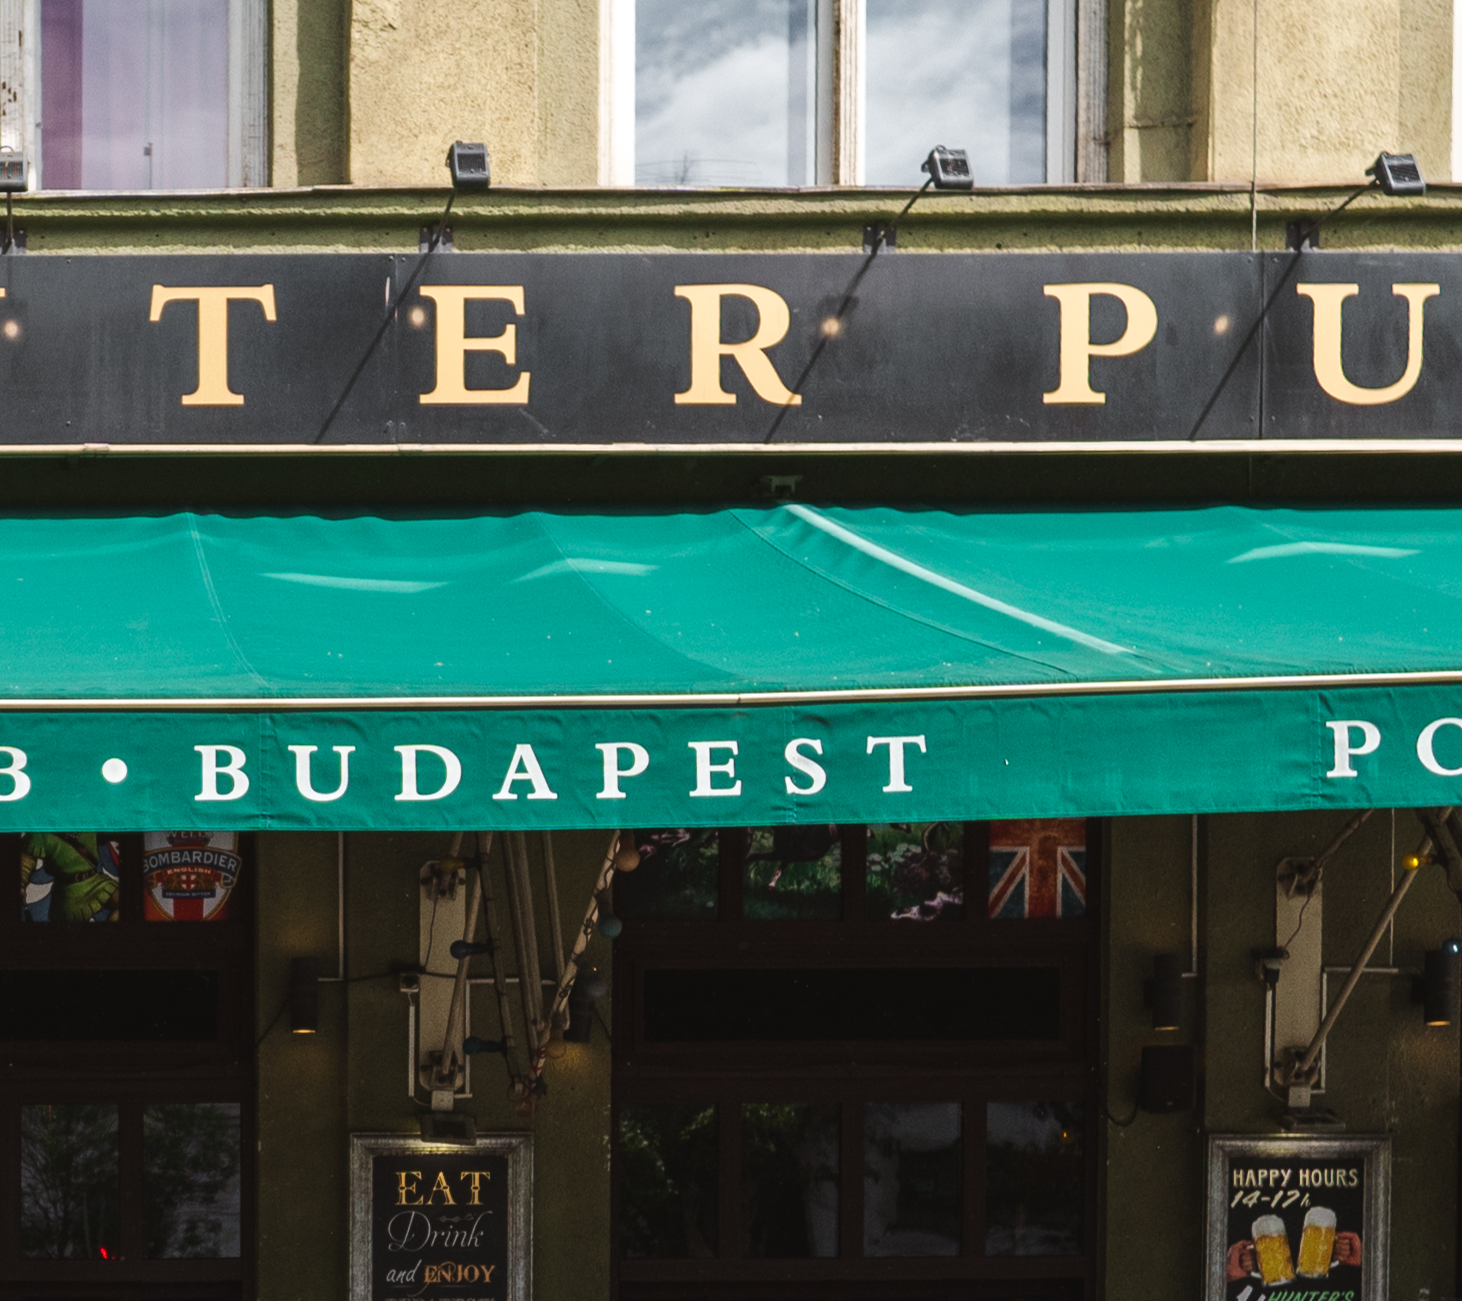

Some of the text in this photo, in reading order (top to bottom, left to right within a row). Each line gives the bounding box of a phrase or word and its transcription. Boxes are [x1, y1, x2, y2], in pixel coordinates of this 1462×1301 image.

[193, 734, 927, 802] BUDAPEST
[143, 851, 237, 873] BOMBARDIER
[394, 1171, 492, 1206] EAT
[1233, 1169, 1360, 1188] HAPPY HOURS
[388, 1211, 494, 1252] Drink
[386, 1259, 496, 1284] and ENJOY
